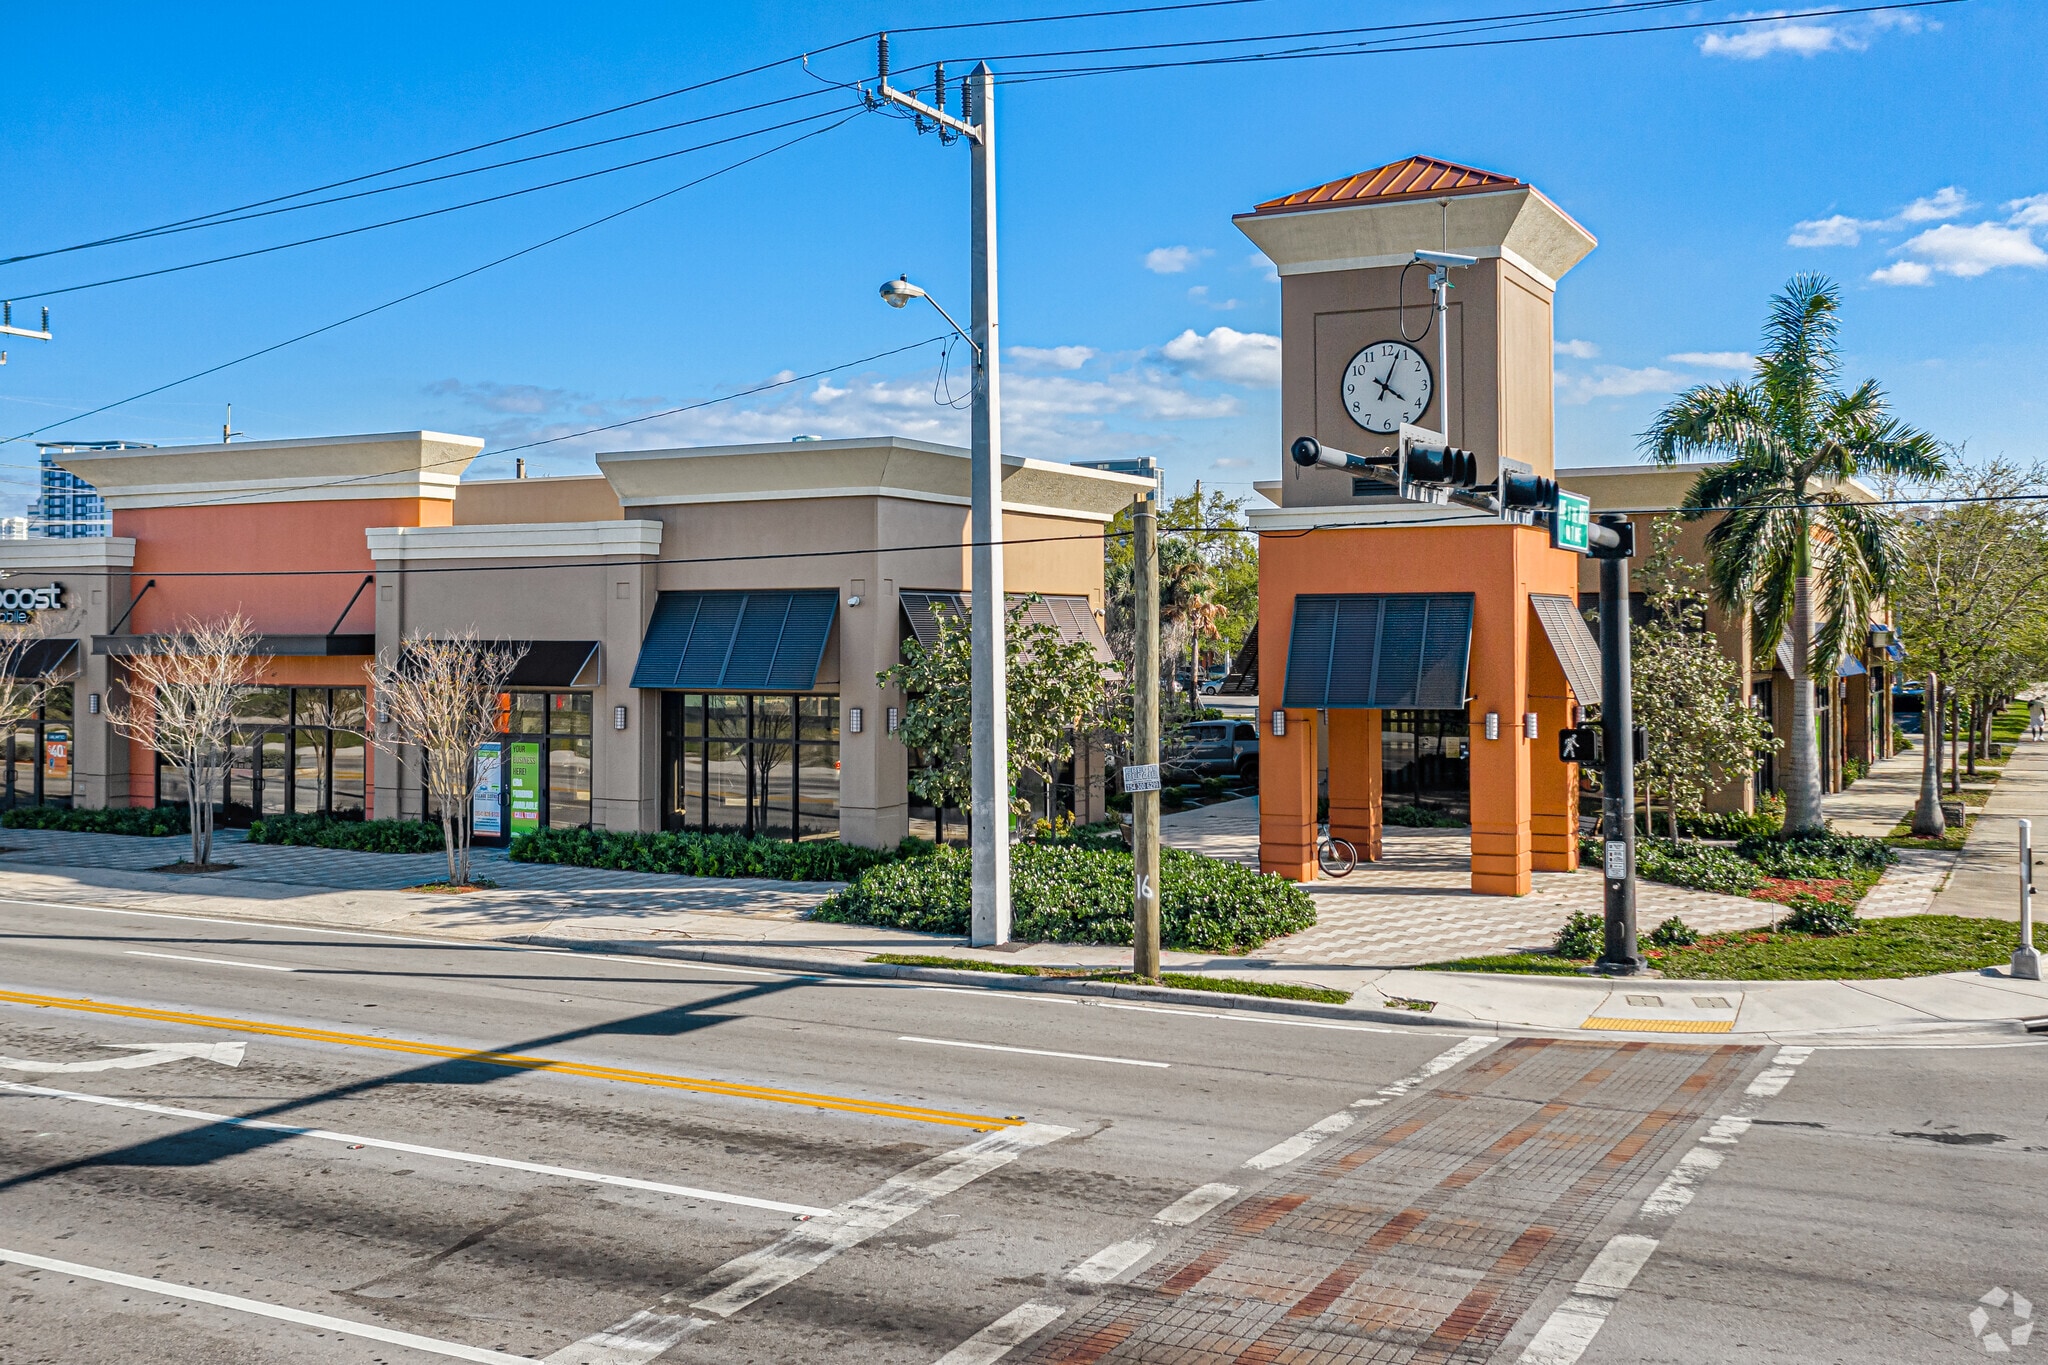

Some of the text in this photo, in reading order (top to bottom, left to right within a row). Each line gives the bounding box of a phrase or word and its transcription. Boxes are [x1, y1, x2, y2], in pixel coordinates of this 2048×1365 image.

[1382, 345, 1394, 356] 12
[1403, 349, 1408, 360] 1
[1364, 352, 1375, 363] 11
[1353, 365, 1366, 376] 10
[1414, 361, 1421, 372] 2
[1347, 384, 1355, 395] 9
[1421, 380, 1428, 391] 3
[1353, 401, 1361, 413] 8
[1414, 397, 1422, 409] 4
[1365, 414, 1372, 425] 7
[1402, 412, 1409, 423] 5
[1383, 419, 1391, 430] 6
[0, 583, 61, 609] oost
[0, 610, 27, 623] obile
[513, 745, 526, 753] YOUR
[513, 756, 536, 765] BUSINESS
[513, 767, 527, 776] HERE!
[1137, 874, 1154, 900] 16
